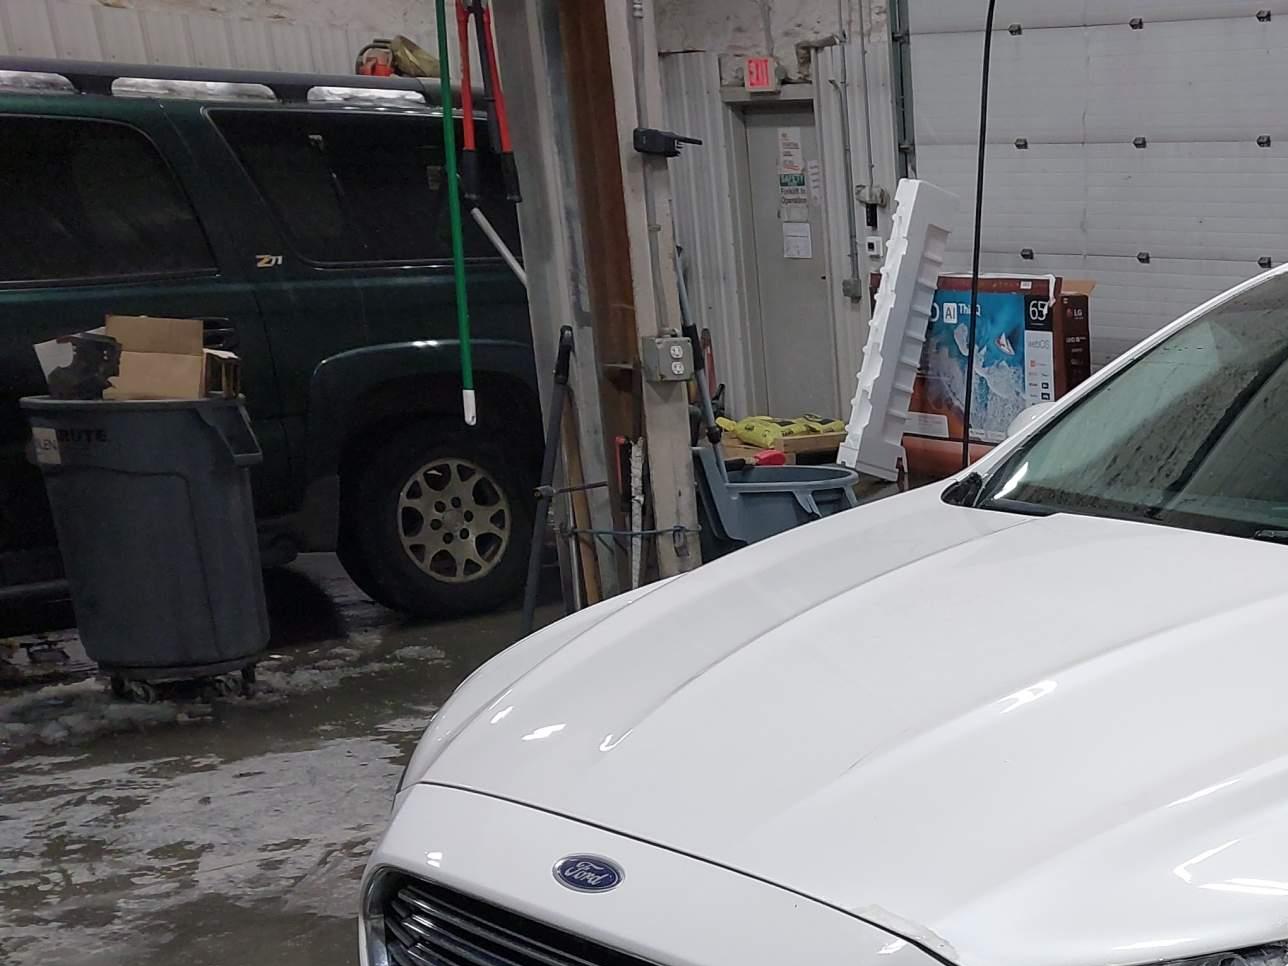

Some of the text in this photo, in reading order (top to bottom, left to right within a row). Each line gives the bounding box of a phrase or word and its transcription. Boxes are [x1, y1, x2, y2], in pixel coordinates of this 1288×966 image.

[748, 59, 769, 86] EXIT
[781, 175, 805, 183] SAFETY
[256, 254, 283, 268] Z71
[1073, 309, 1083, 317] LG
[564, 861, 609, 886] Ford
